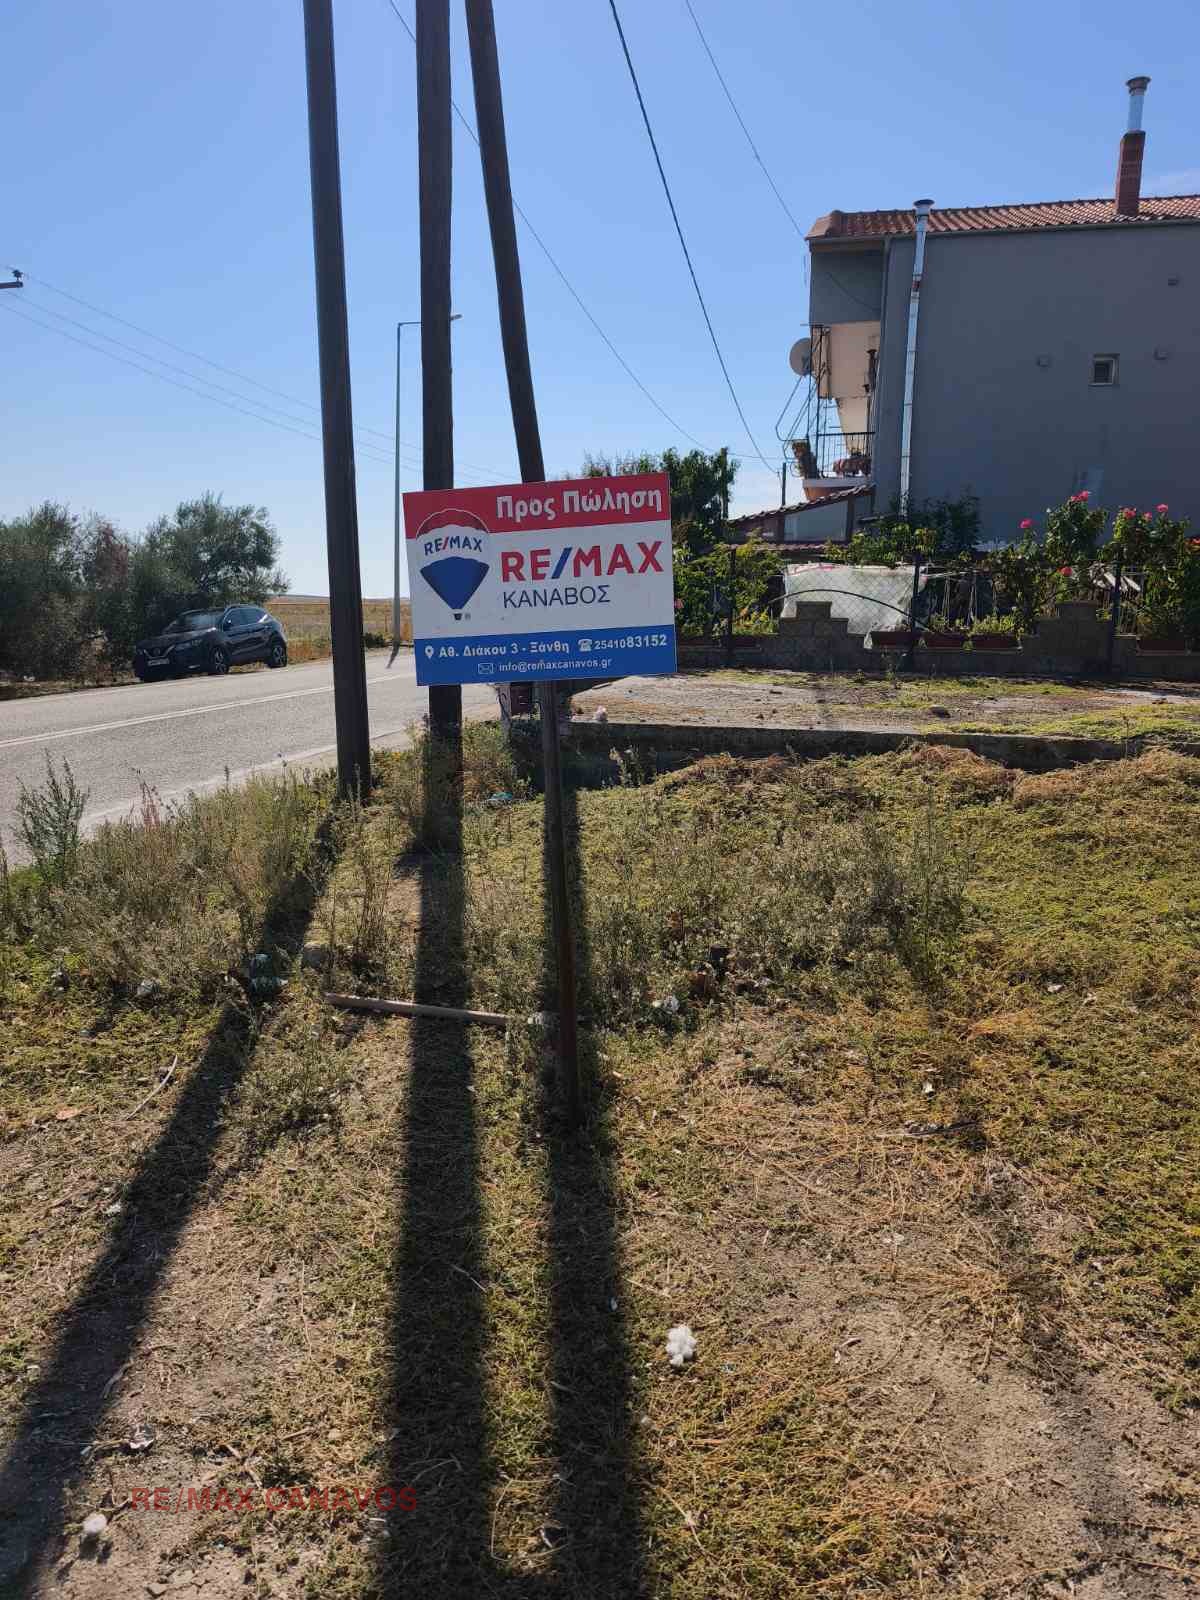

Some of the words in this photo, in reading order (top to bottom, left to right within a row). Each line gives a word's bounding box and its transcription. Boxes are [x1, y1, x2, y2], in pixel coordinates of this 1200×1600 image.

[496, 495, 556, 523] Προς
[563, 487, 662, 515] Πώληση
[424, 535, 483, 556] RE/MAX
[500, 540, 665, 583] RE/MAX
[503, 584, 612, 609] ΚΑΝΑΒΟΣ
[511, 642, 519, 654] 3
[530, 640, 569, 654] Ξάνθη
[594, 633, 668, 650] 2541083152
